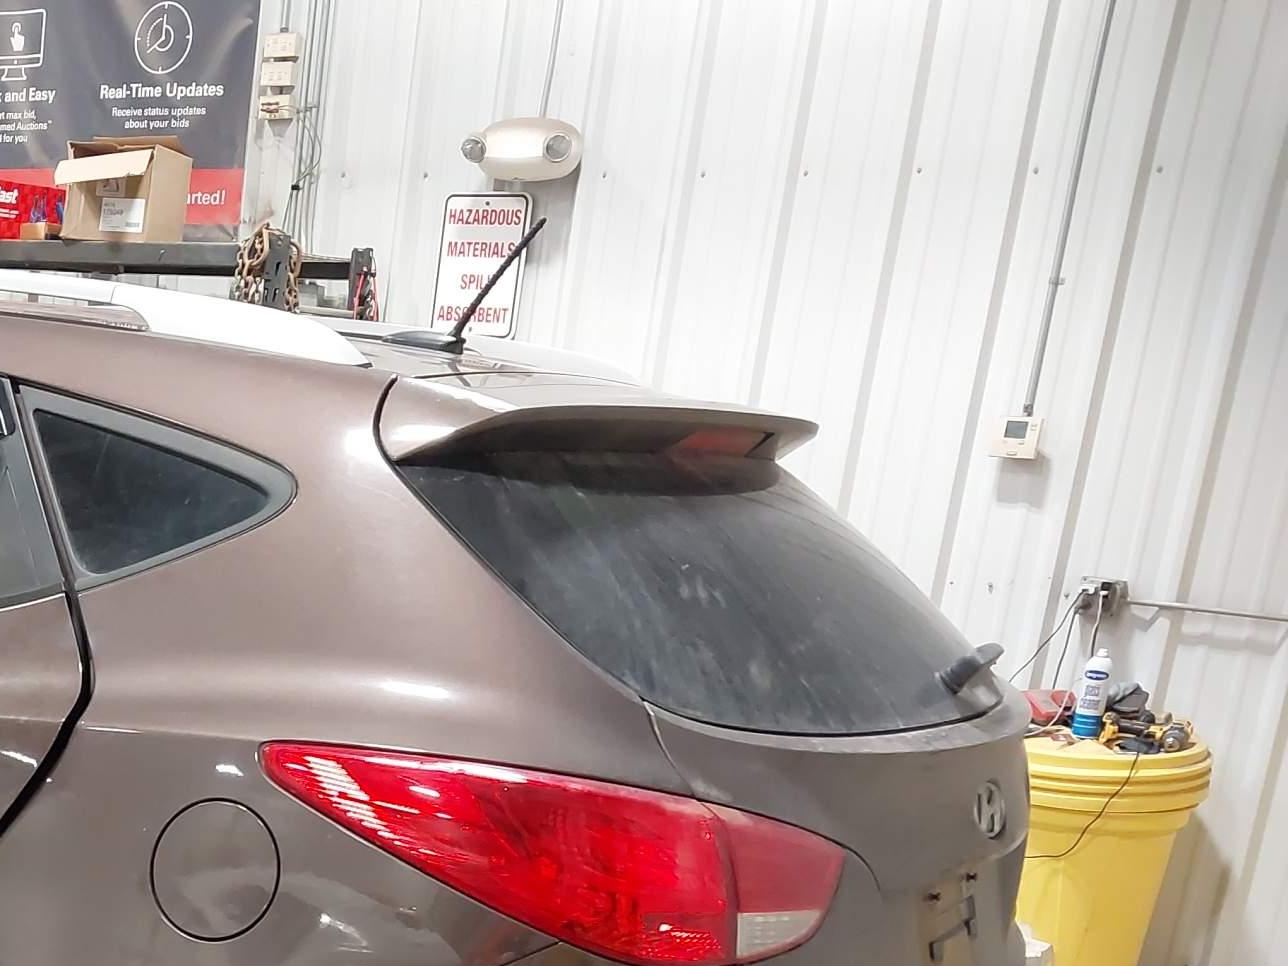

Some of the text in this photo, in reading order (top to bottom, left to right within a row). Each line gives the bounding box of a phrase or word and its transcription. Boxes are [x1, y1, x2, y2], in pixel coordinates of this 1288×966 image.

[4, 88, 27, 103] and
[28, 87, 57, 103] Easy
[100, 82, 225, 100] Real-Time Updates
[6, 112, 23, 120] max
[24, 109, 36, 120] bid,
[112, 106, 206, 117] Receive status updates
[124, 118, 190, 130] about your bids
[2, 134, 14, 143] for
[14, 134, 28, 144] you
[448, 208, 523, 226] HAZARDOUS
[447, 241, 516, 258] MATERIALS
